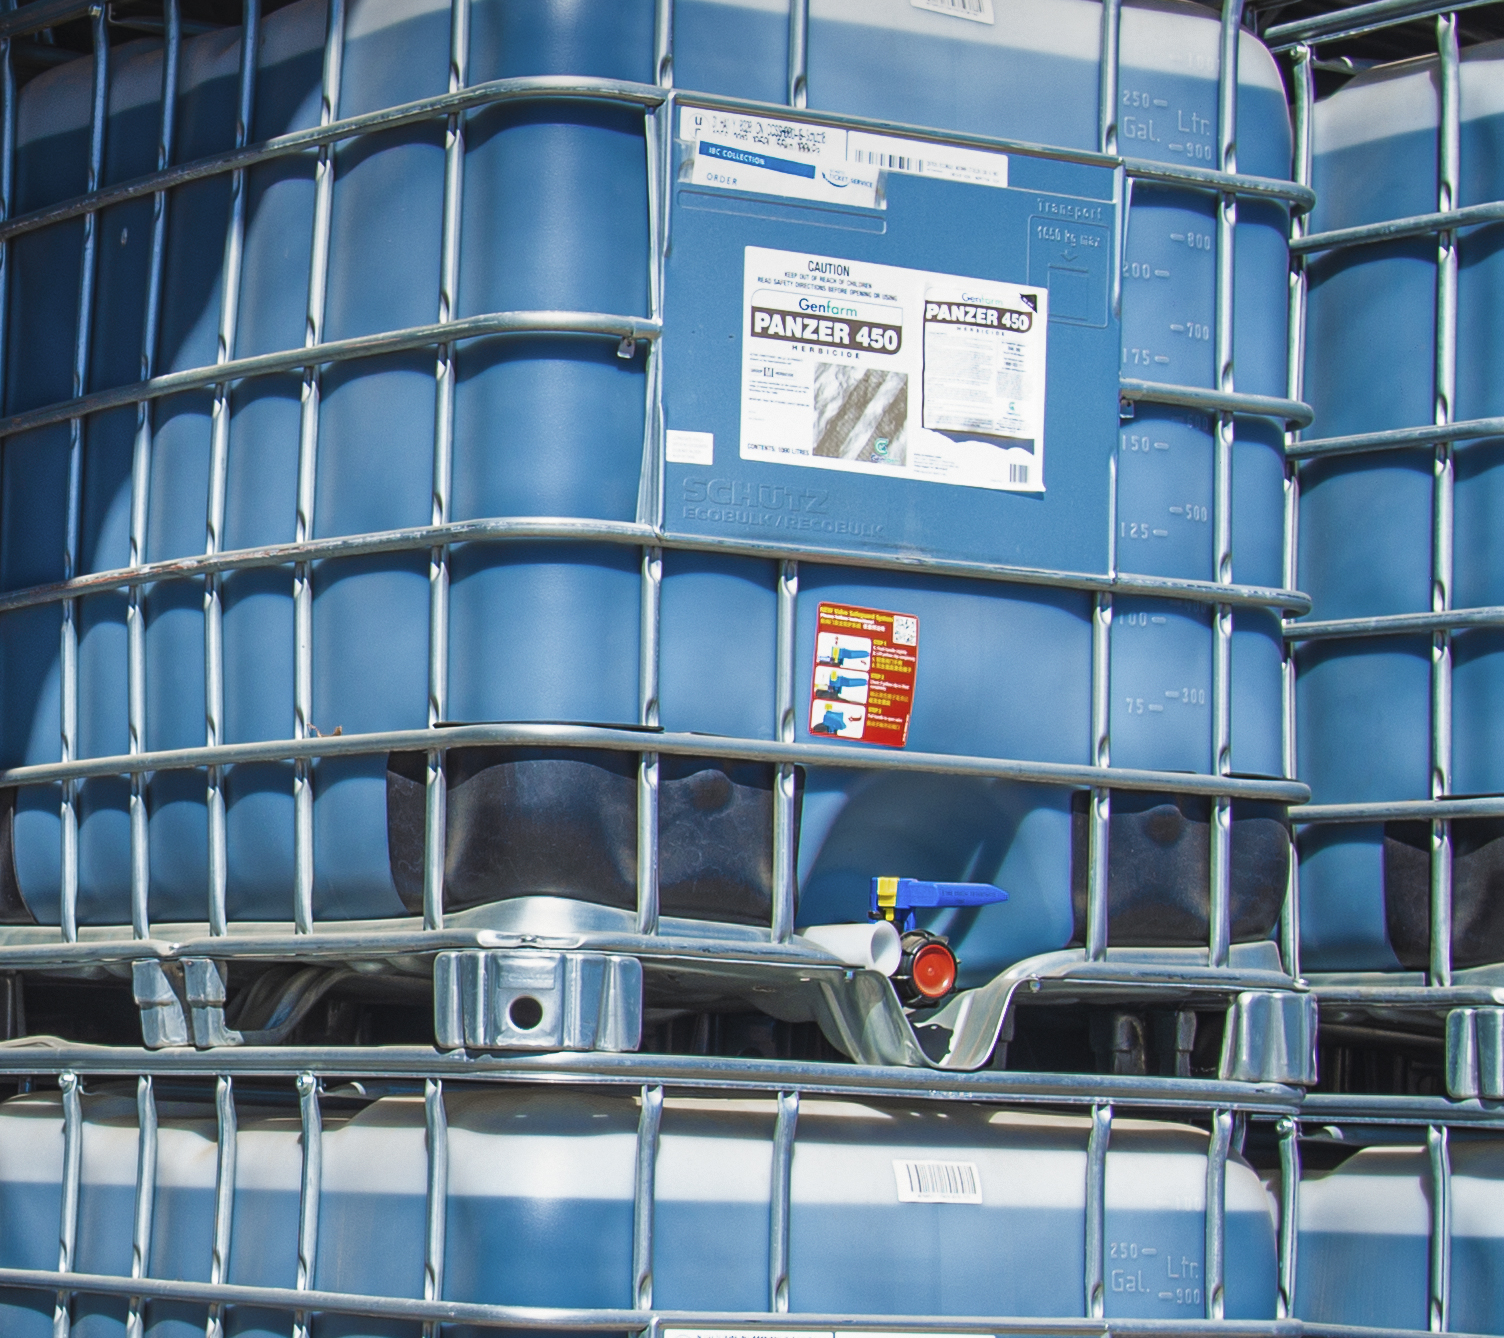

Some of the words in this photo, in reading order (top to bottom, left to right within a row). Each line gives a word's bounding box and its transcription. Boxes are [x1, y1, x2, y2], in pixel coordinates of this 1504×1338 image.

[1123, 90, 1150, 108] 250
[1124, 115, 1161, 143] Gal.
[709, 146, 720, 155] IBC
[722, 149, 765, 165] COLLECTION
[706, 172, 738, 186] ORDER
[808, 260, 850, 277] CAUTION
[1123, 262, 1150, 279] 200
[799, 298, 857, 317] Genfarm
[926, 304, 998, 326] PANZER
[1001, 312, 1030, 330] 450
[754, 311, 850, 344] PANZER
[855, 326, 898, 351] 450
[1185, 322, 1209, 341] 700
[792, 345, 860, 359] HERBICIDE
[1109, 1243, 1138, 1259] 250
[1111, 1267, 1150, 1295] Gal.
